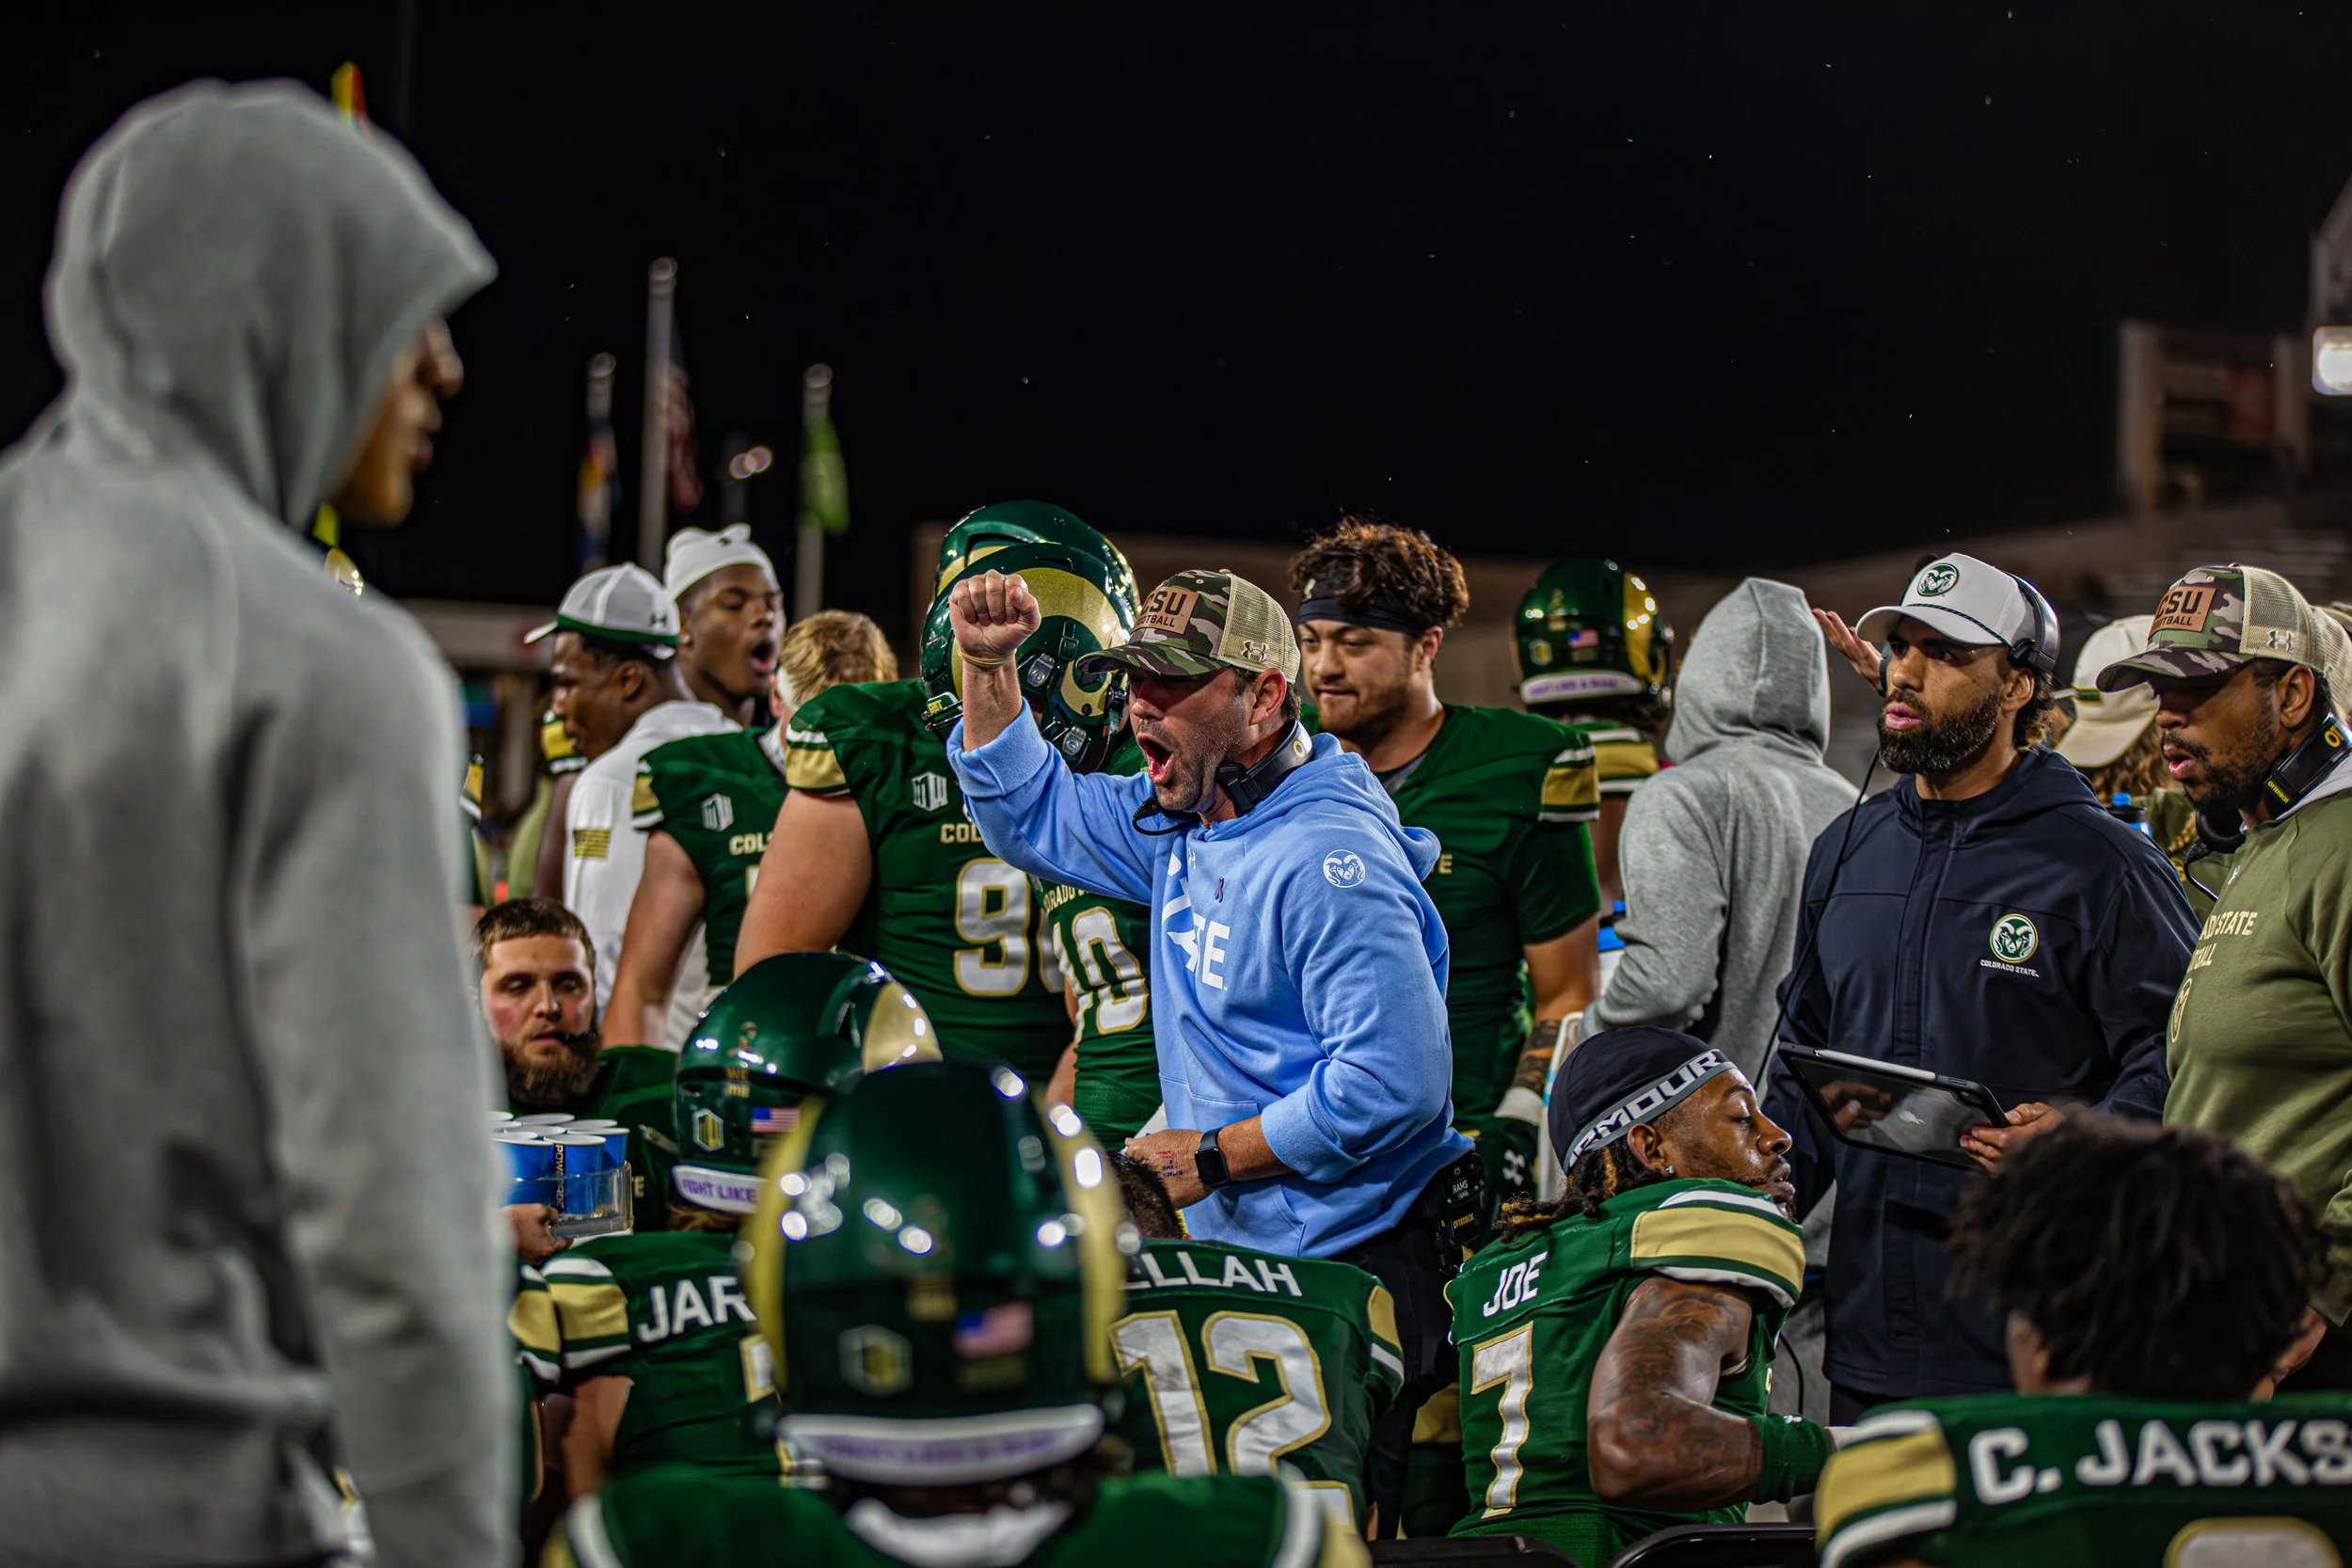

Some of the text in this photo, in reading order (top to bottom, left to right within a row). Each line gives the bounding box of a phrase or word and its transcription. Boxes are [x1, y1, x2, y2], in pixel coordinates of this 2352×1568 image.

[1140, 590, 1187, 616] CSU
[2155, 590, 2203, 617] CSU
[953, 857, 1066, 997] 9
[2215, 911, 2258, 936] STATE
[1979, 958, 2037, 977] COLORADO STATE
[1482, 1250, 1549, 1318] JOE
[1107, 1308, 1353, 1528] 12
[1470, 1320, 1534, 1520] 7
[1967, 1418, 2352, 1506] C. JACKS
